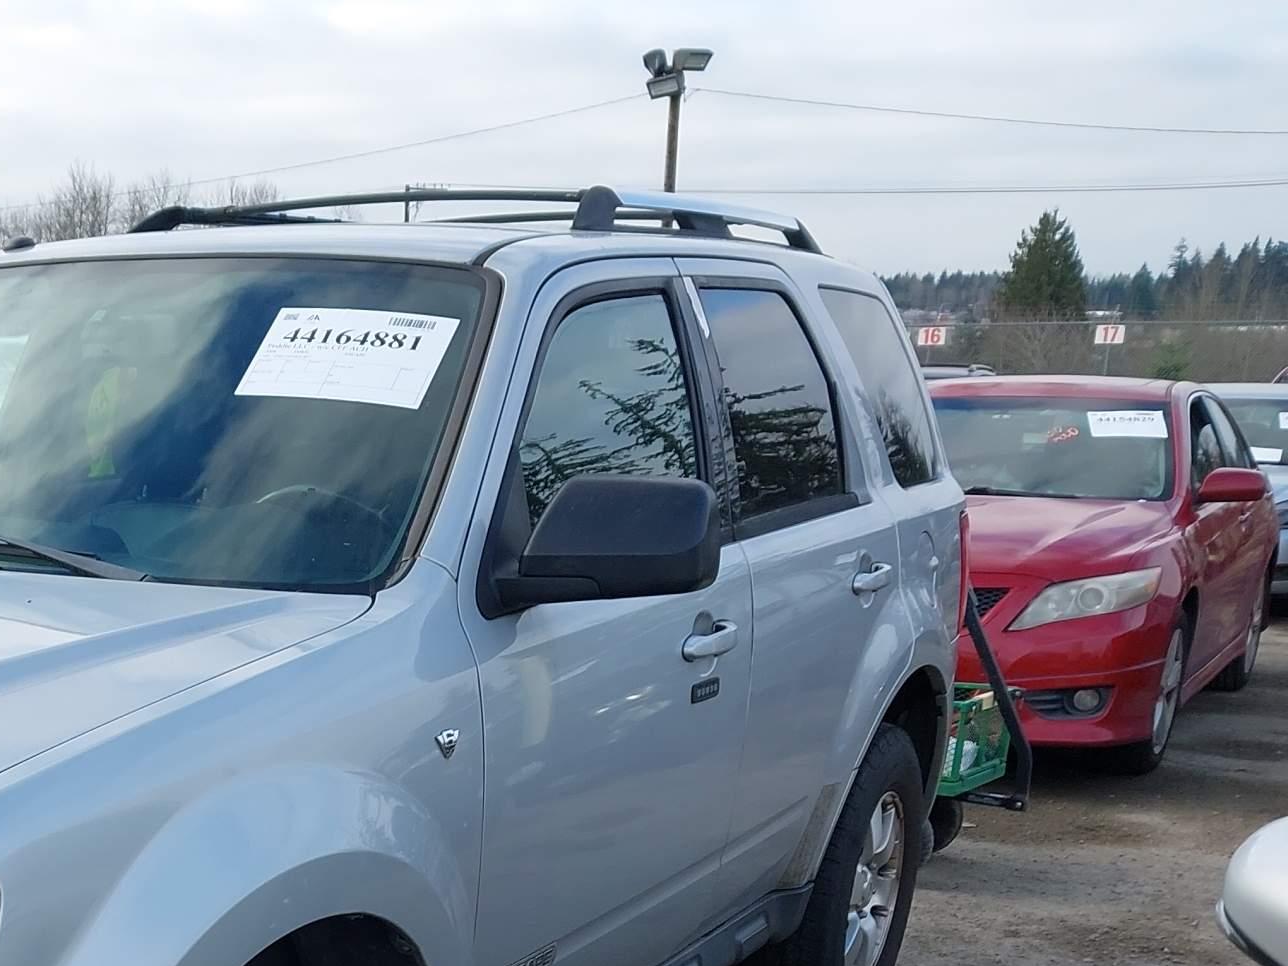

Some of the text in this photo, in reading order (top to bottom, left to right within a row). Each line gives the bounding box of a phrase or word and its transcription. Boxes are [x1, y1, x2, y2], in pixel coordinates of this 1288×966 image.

[282, 327, 423, 351] 44164881
[922, 328, 942, 344] 16
[1102, 326, 1120, 342] 17
